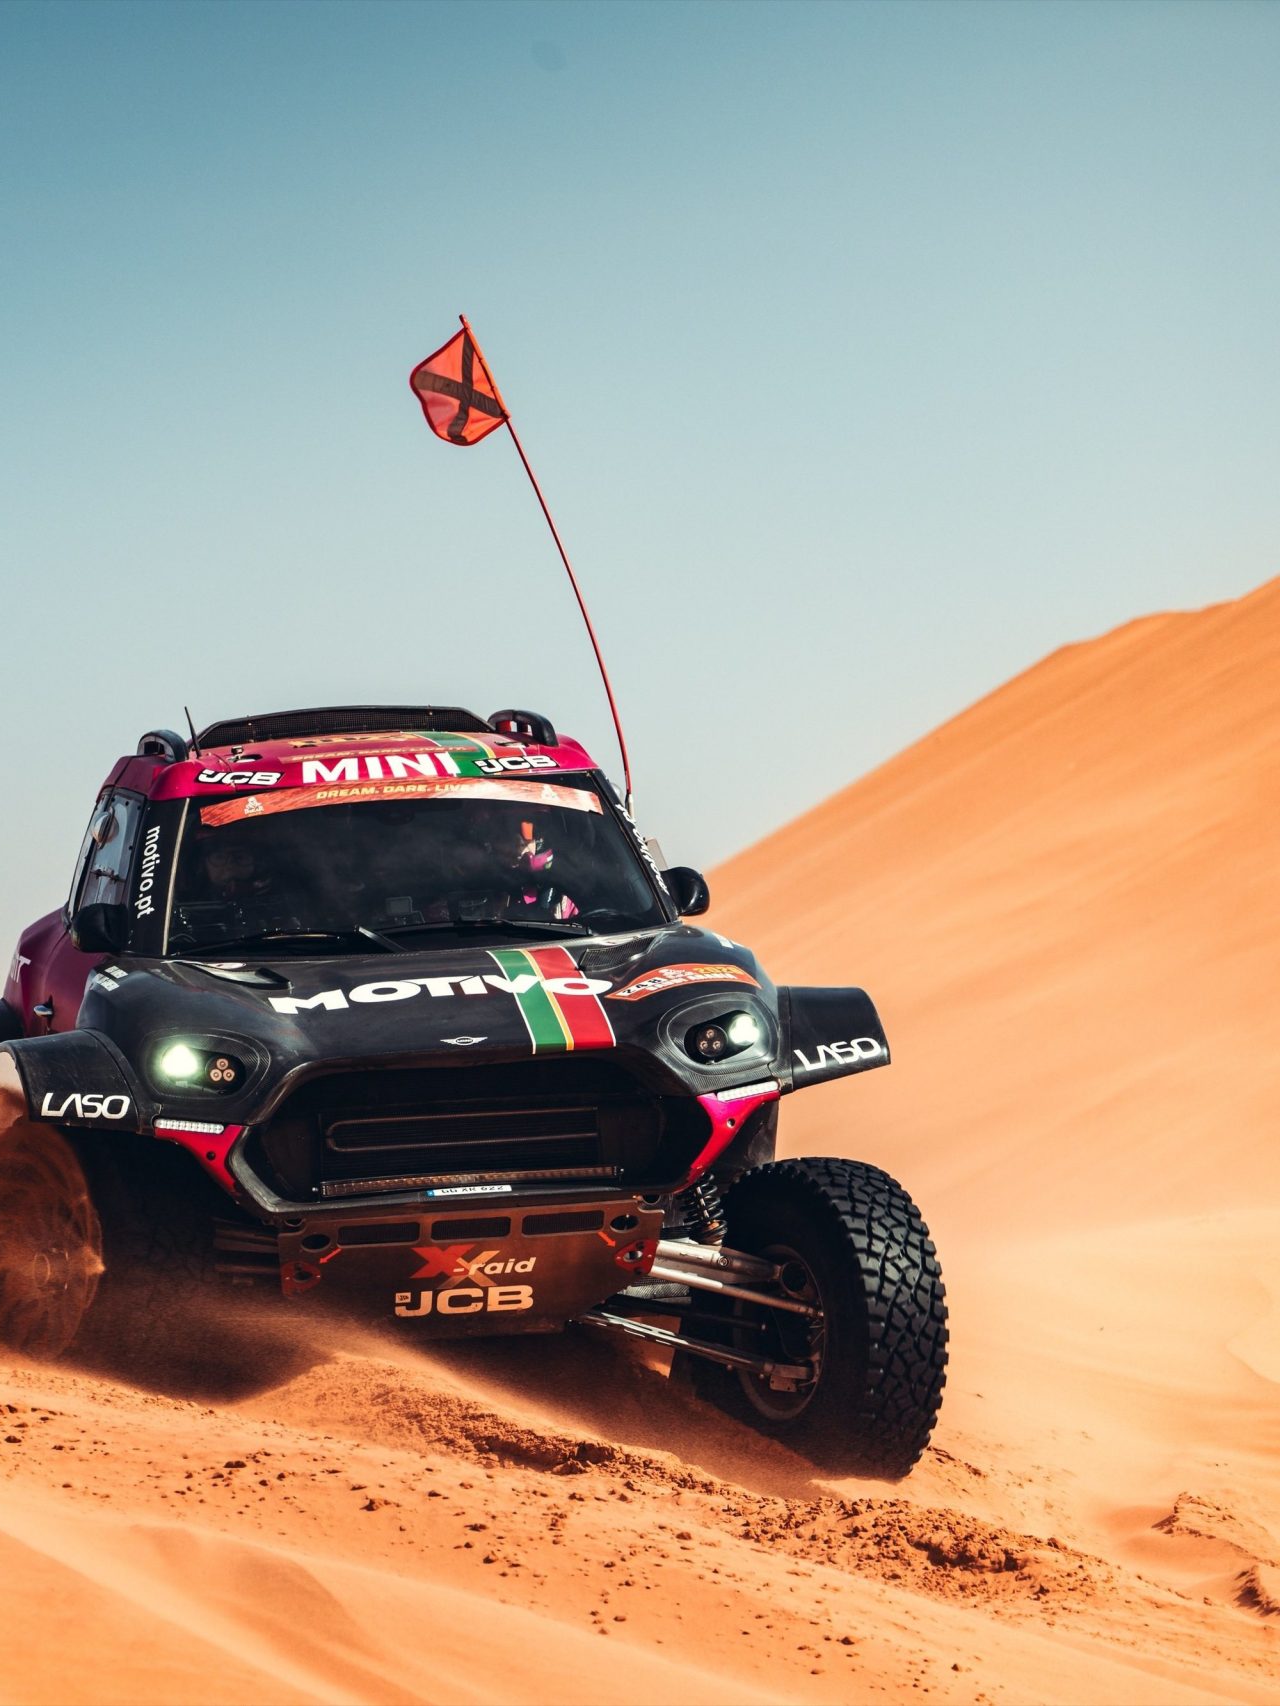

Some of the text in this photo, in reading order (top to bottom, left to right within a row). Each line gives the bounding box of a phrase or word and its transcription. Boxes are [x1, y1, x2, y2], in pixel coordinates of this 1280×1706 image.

[198, 768, 281, 785] JCB
[302, 751, 462, 784] MINI
[474, 755, 558, 773] JCB
[316, 786, 379, 799] DREAM.
[383, 784, 431, 793] DARE.
[134, 825, 160, 919] motivo.pt
[268, 974, 613, 1015] MOTIVO
[793, 1037, 882, 1071] LASO
[41, 1092, 131, 1119] LASO
[395, 1284, 534, 1318] JCB
